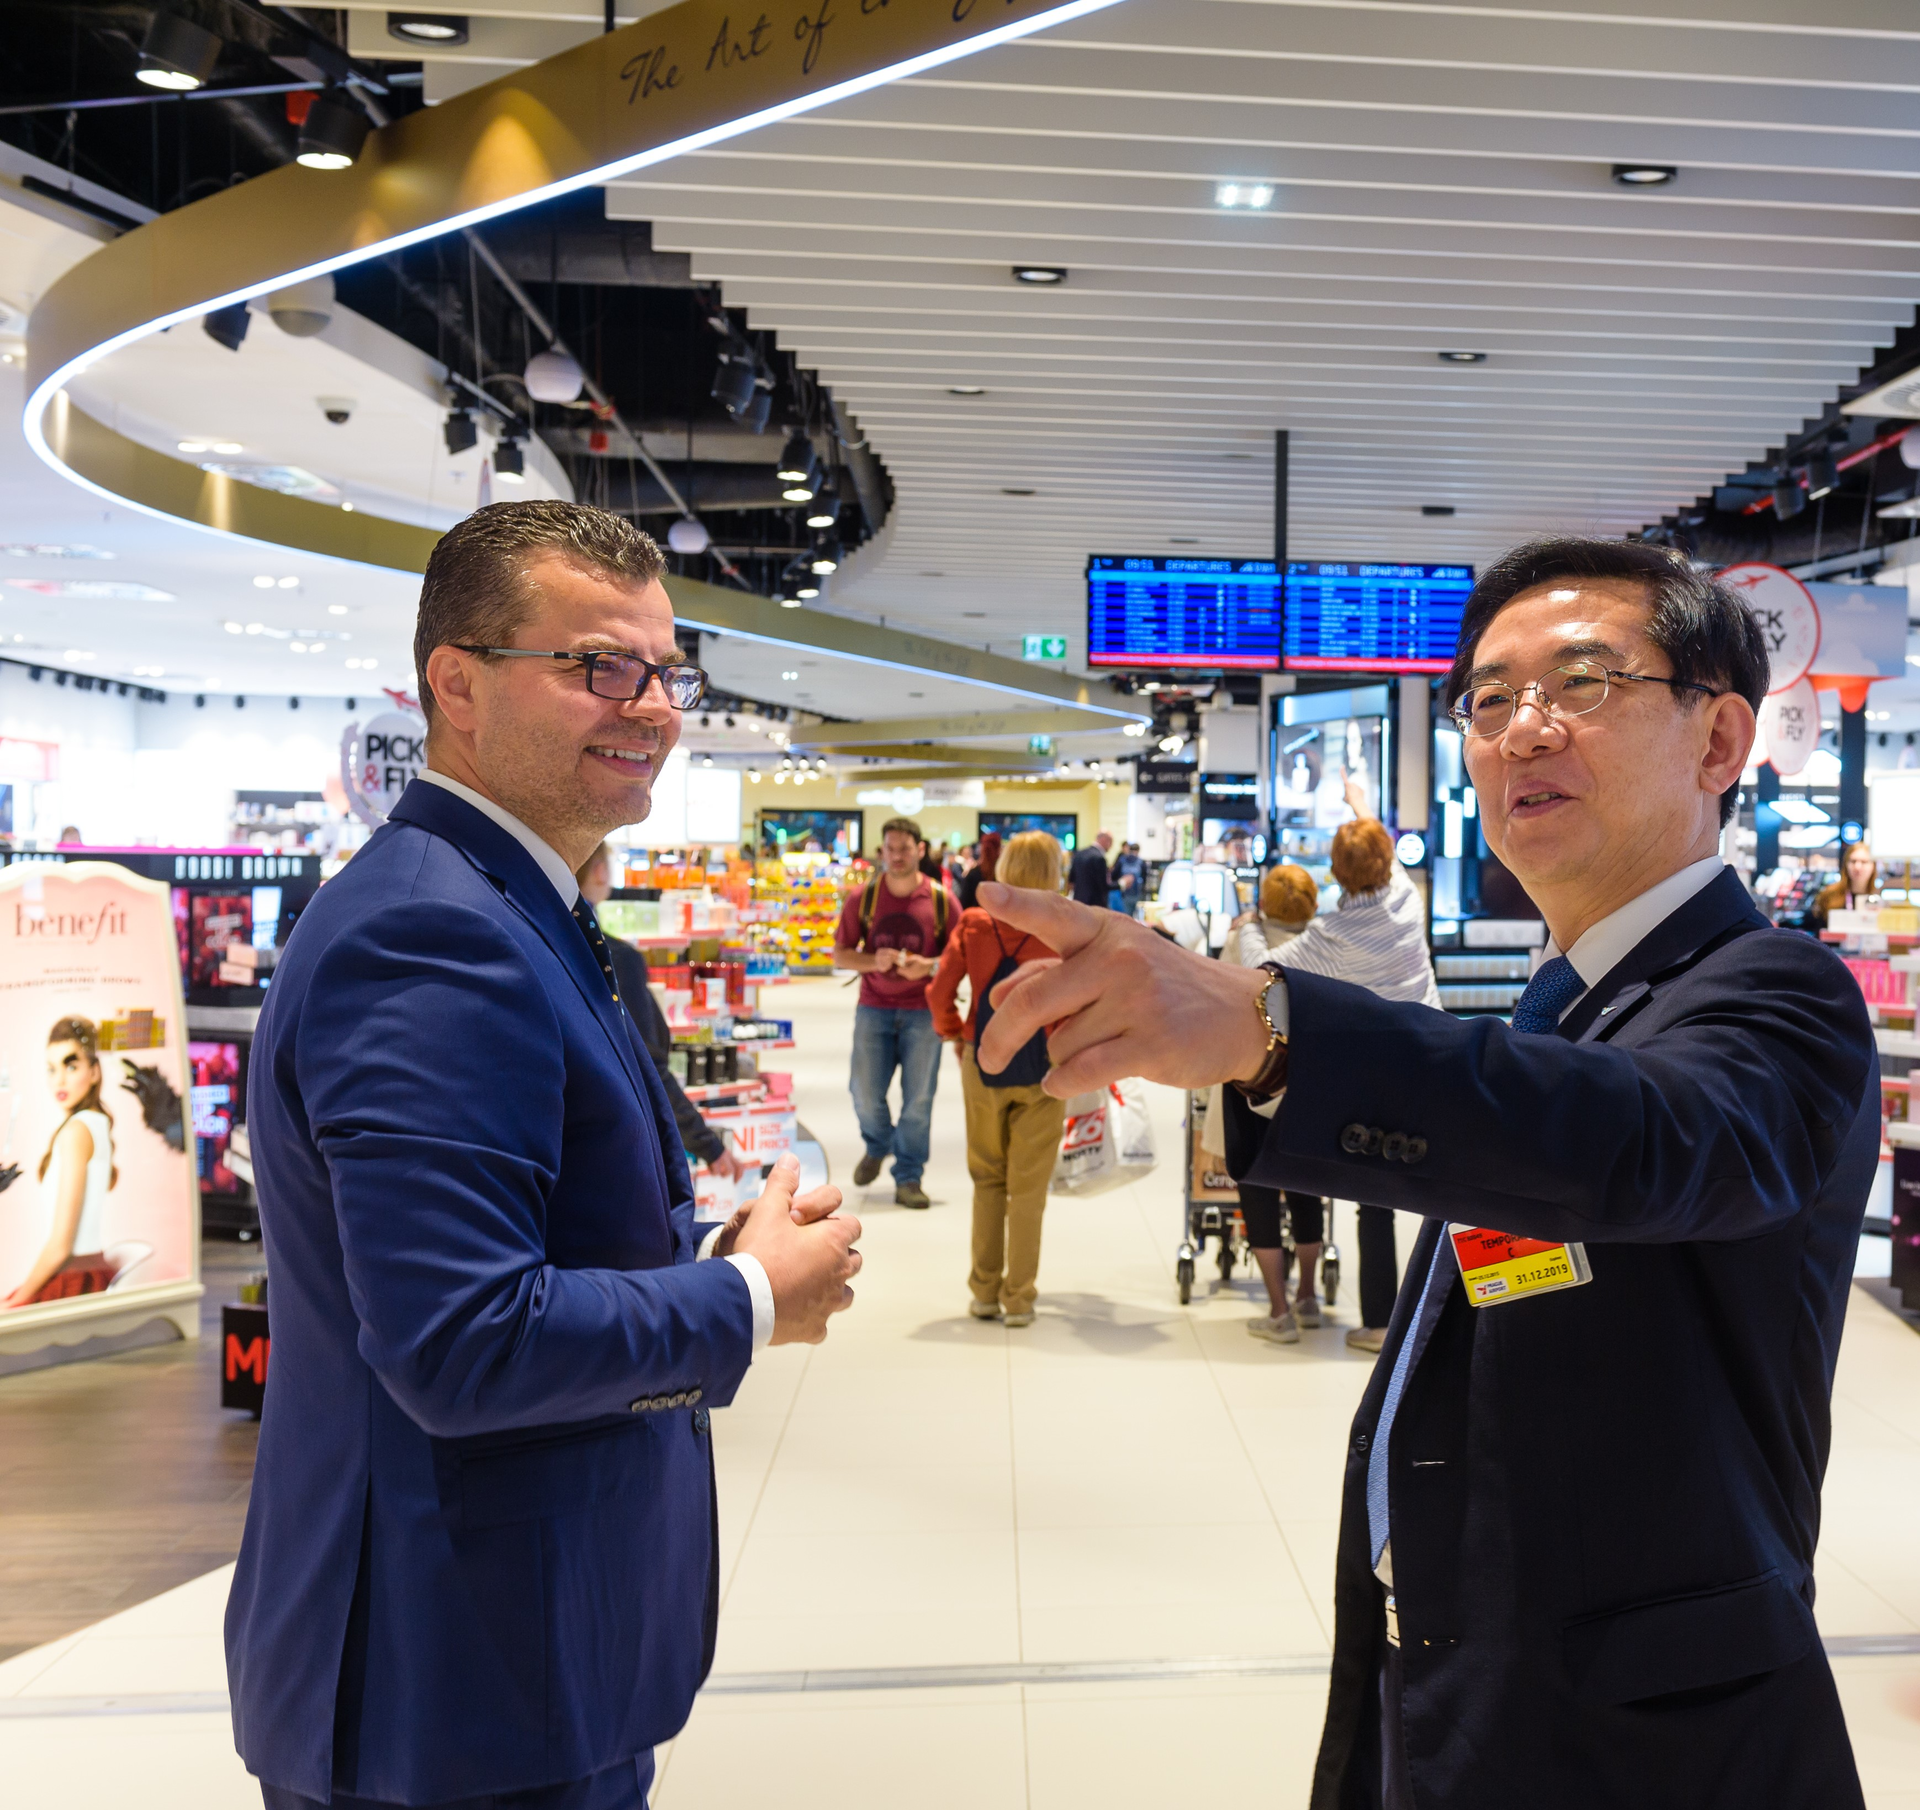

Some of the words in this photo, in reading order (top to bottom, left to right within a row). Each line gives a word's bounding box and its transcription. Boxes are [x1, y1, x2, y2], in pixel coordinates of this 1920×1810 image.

[620, 46, 681, 105] The
[705, 14, 771, 71] Art
[794, 0, 834, 75] of
[1166, 560, 1231, 572] DEPARTURES
[1359, 565, 1424, 577] DEPARTURES
[366, 734, 425, 763] PICK
[362, 763, 382, 793] &
[175, 856, 234, 879] BOBBI
[242, 857, 303, 879] BROWN
[15, 901, 129, 944] benefit
[1508, 1247, 1515, 1258] C
[1516, 1264, 1568, 1284] 31.12.2019
